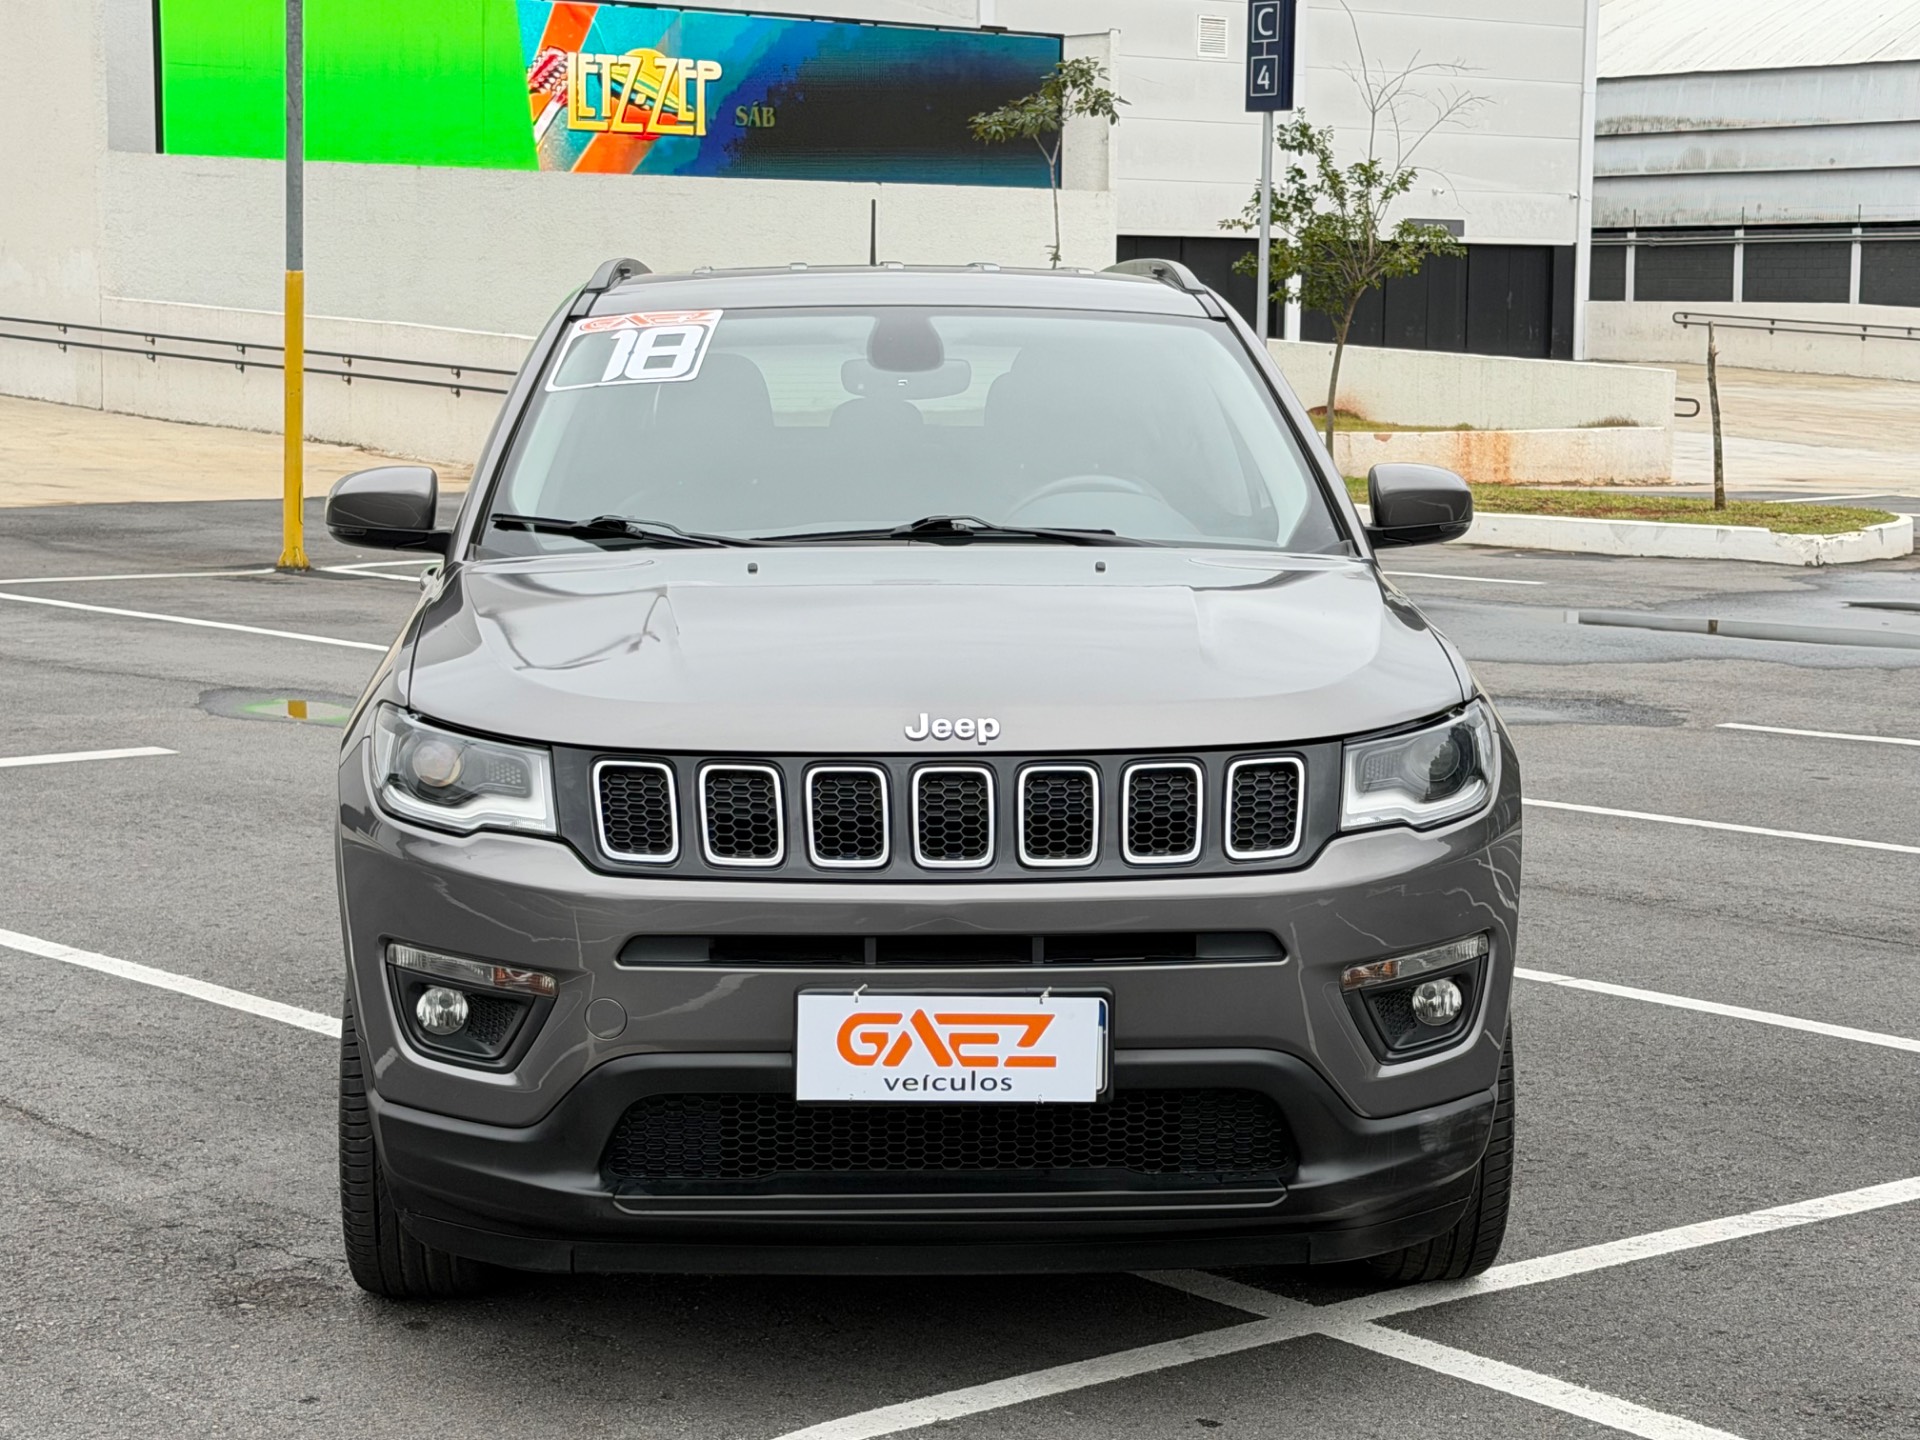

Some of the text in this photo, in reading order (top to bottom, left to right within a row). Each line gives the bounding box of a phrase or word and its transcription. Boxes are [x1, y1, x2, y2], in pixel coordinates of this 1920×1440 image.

[1257, 7, 1274, 36] C
[1257, 64, 1270, 90] 4
[735, 102, 776, 128] SÁB
[601, 326, 704, 382] 18
[905, 712, 1000, 745] Jeep
[837, 1009, 1056, 1067] GAEZ
[884, 1070, 1013, 1092] veículos
